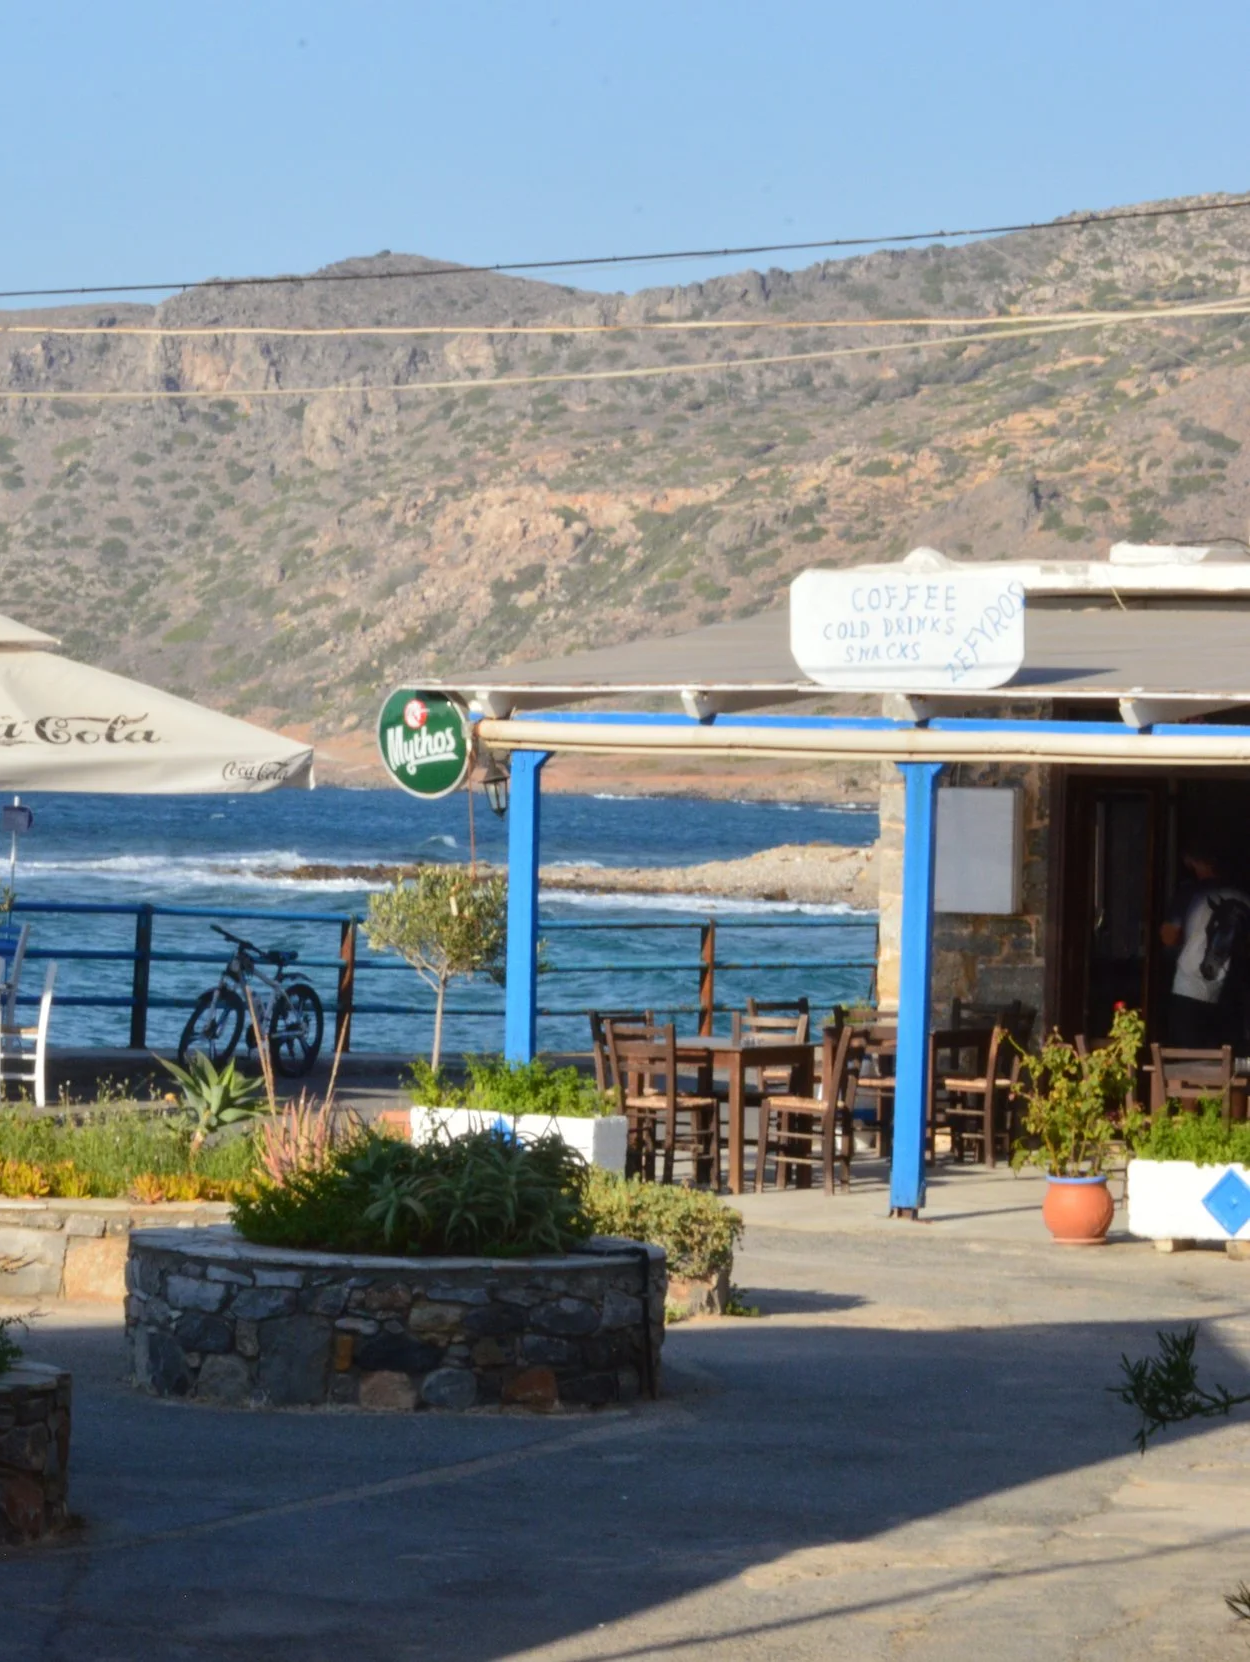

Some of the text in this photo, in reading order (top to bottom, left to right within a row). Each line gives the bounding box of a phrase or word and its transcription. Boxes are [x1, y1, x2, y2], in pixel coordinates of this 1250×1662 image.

[851, 585, 957, 612] COFFEE
[823, 615, 957, 641] COLD DRINKS
[945, 579, 1025, 683] ZEFYROS
[843, 640, 921, 663] SNACKS
[386, 725, 457, 776] Mythos
